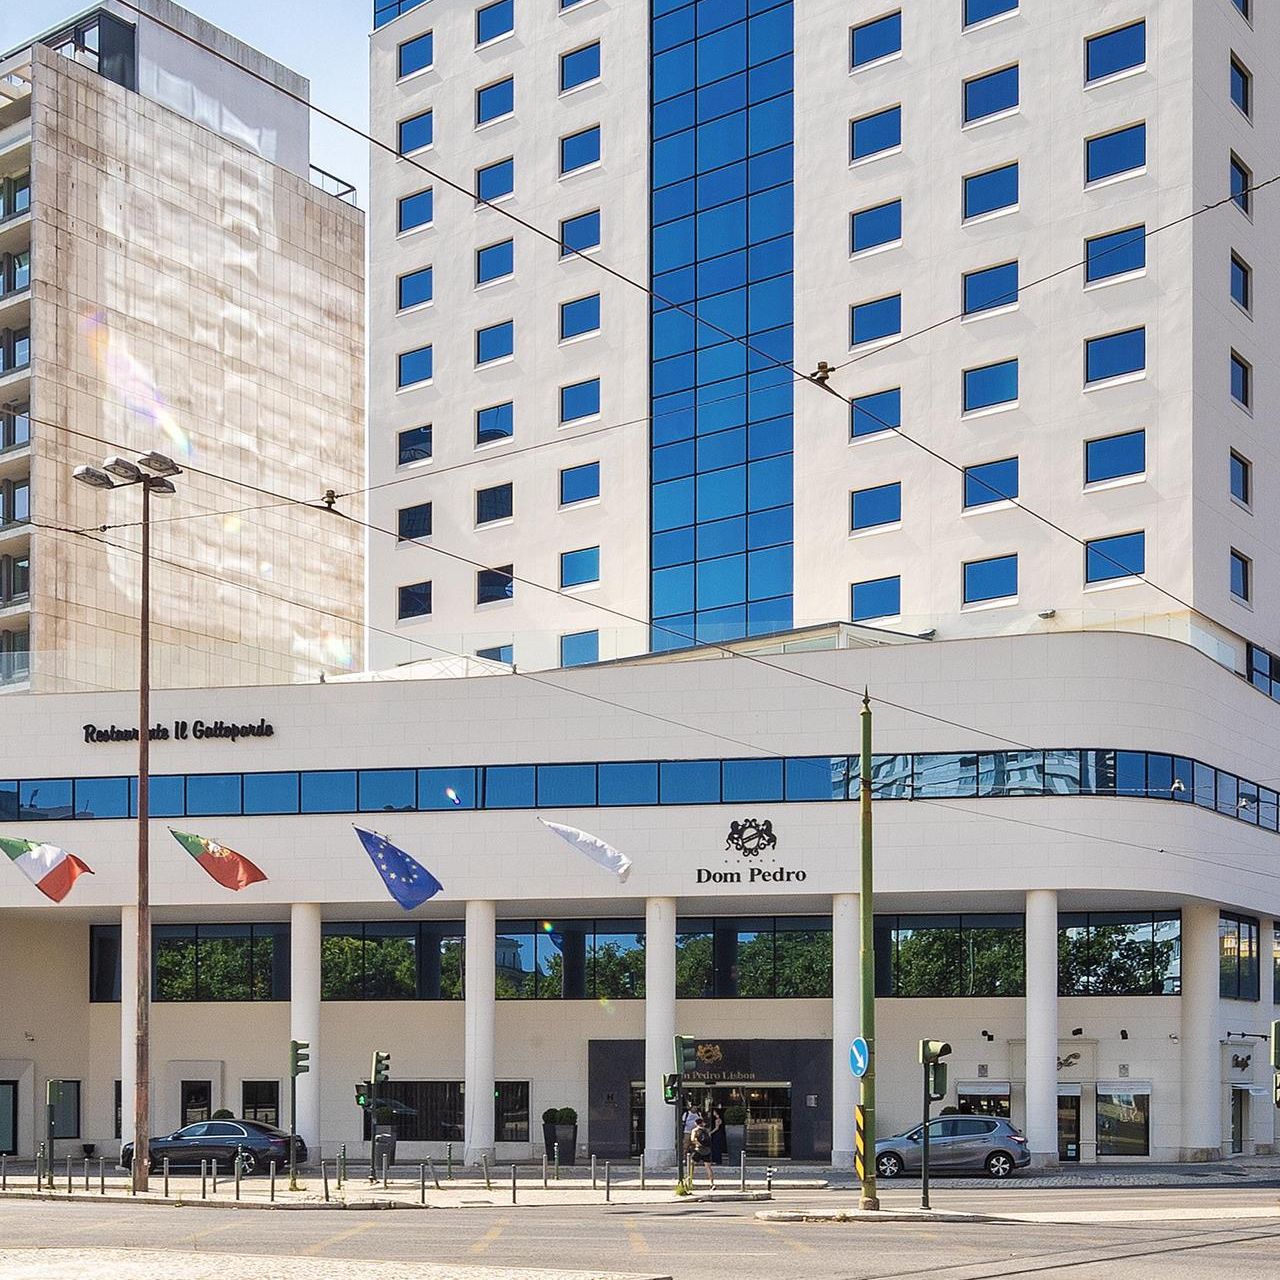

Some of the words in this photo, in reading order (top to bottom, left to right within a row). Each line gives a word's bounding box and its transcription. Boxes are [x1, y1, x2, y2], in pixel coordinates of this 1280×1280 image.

[83, 724, 170, 743] Restaurnte
[175, 721, 188, 740] Il
[193, 718, 274, 742] Gattopardo
[696, 868, 741, 883] Dom
[749, 867, 807, 882] Pedro
[723, 1071, 755, 1080] Lisboa
